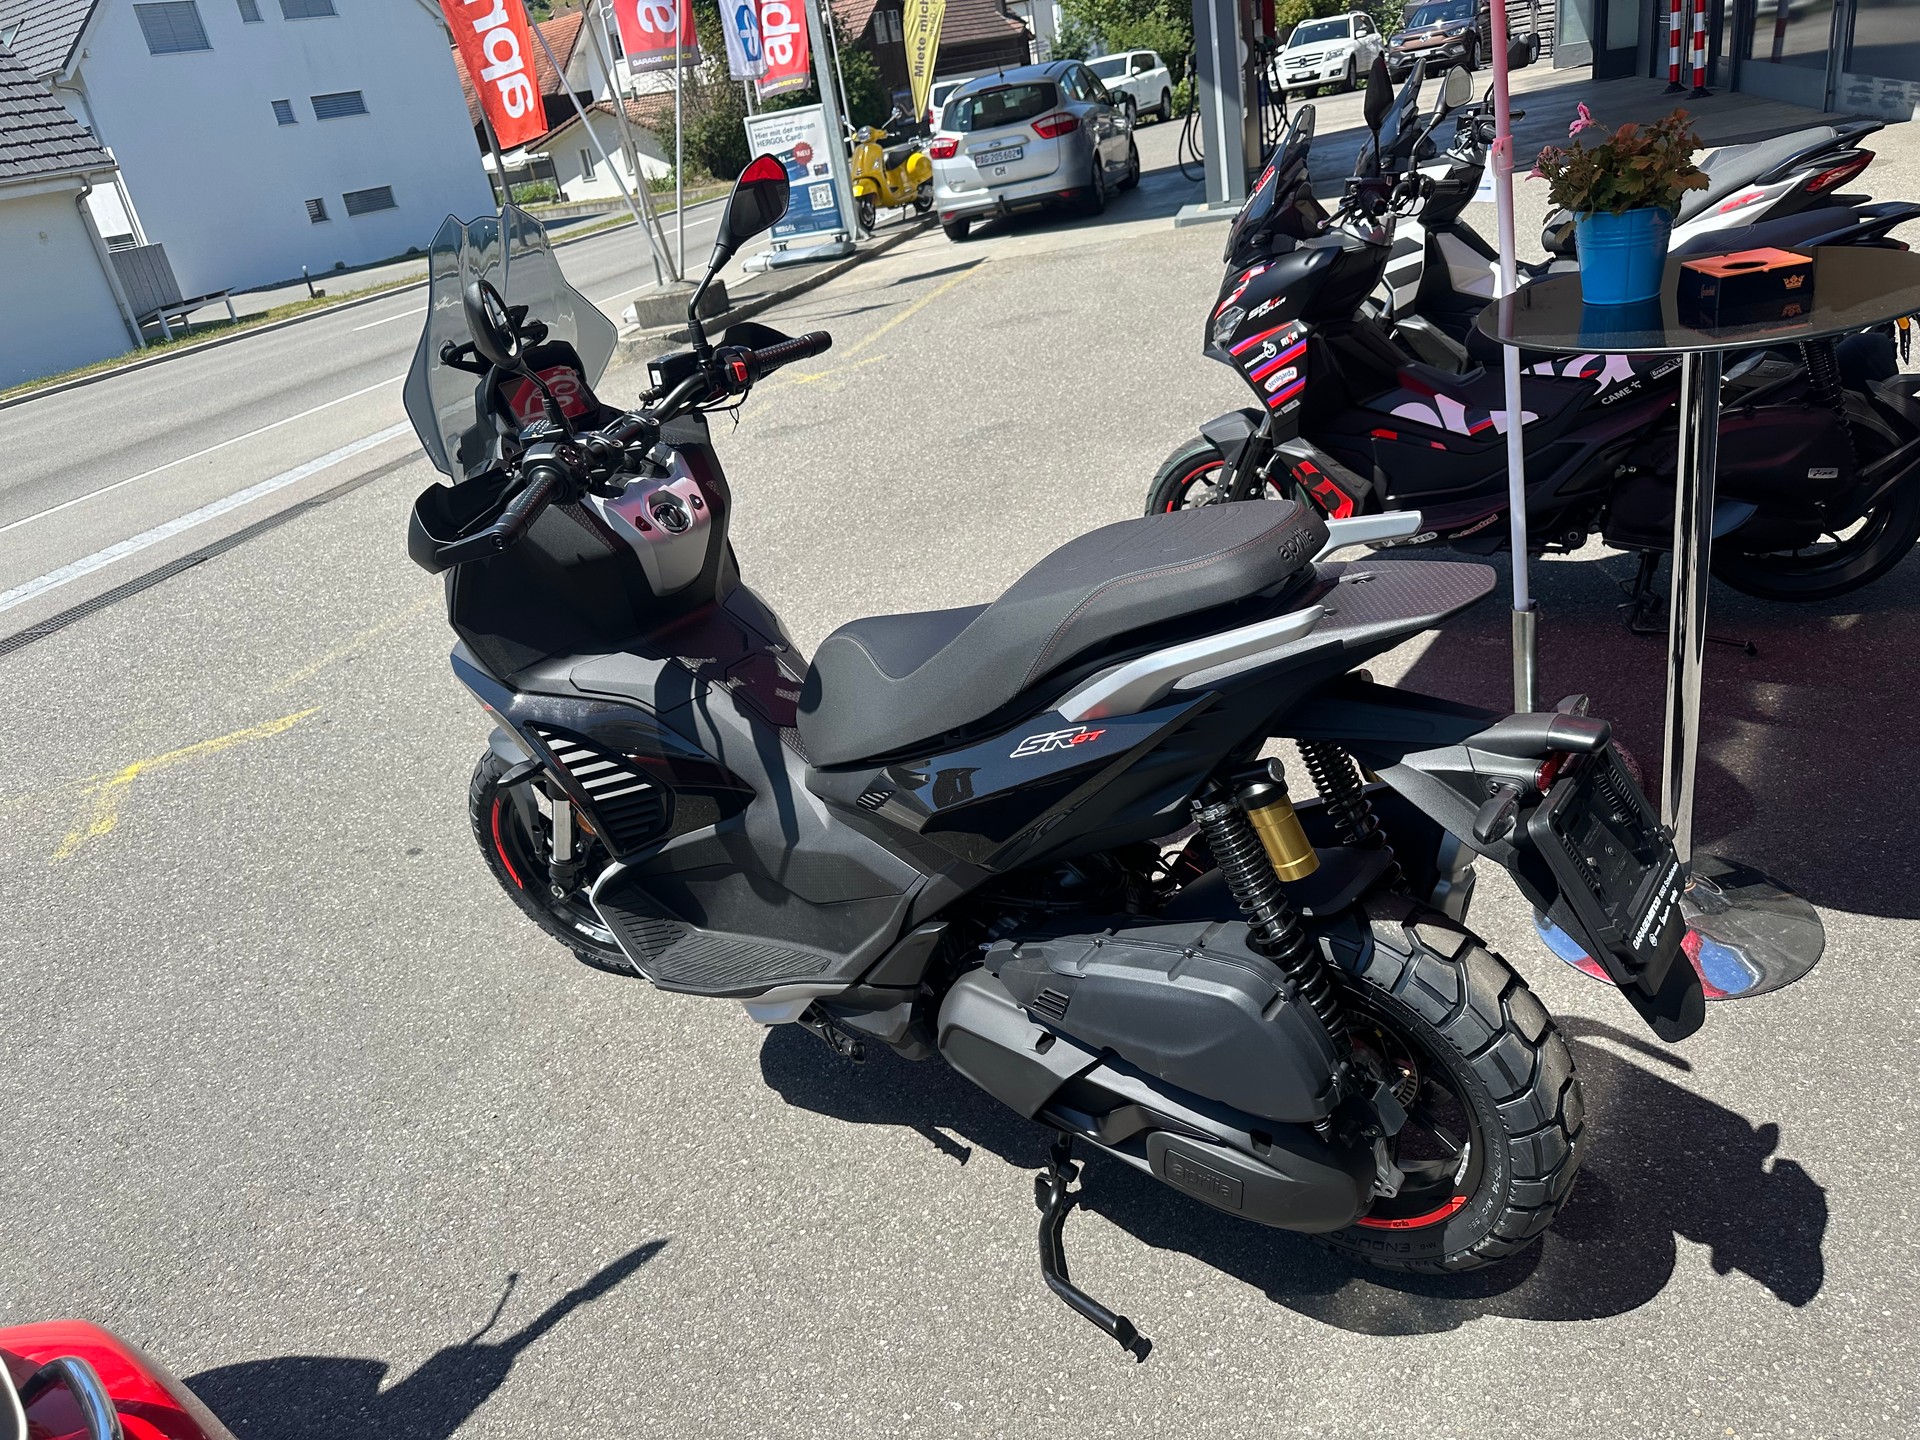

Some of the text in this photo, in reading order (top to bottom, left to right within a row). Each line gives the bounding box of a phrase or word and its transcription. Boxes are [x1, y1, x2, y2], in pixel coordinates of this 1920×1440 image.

[914, 38, 927, 78] Miete
[754, 131, 769, 141] Hier
[769, 129, 781, 138] mit
[782, 126, 793, 135] der
[794, 122, 816, 132] neuen
[796, 149, 811, 158] NEU
[994, 166, 1007, 176] CH
[1267, 369, 1295, 390] sterilgarda
[1601, 386, 1633, 406] CAME
[1460, 514, 1499, 537] Castrol
[1277, 528, 1315, 562] aprilia
[1172, 1162, 1234, 1200] aprilia
[1330, 1231, 1411, 1254] ENDURO
